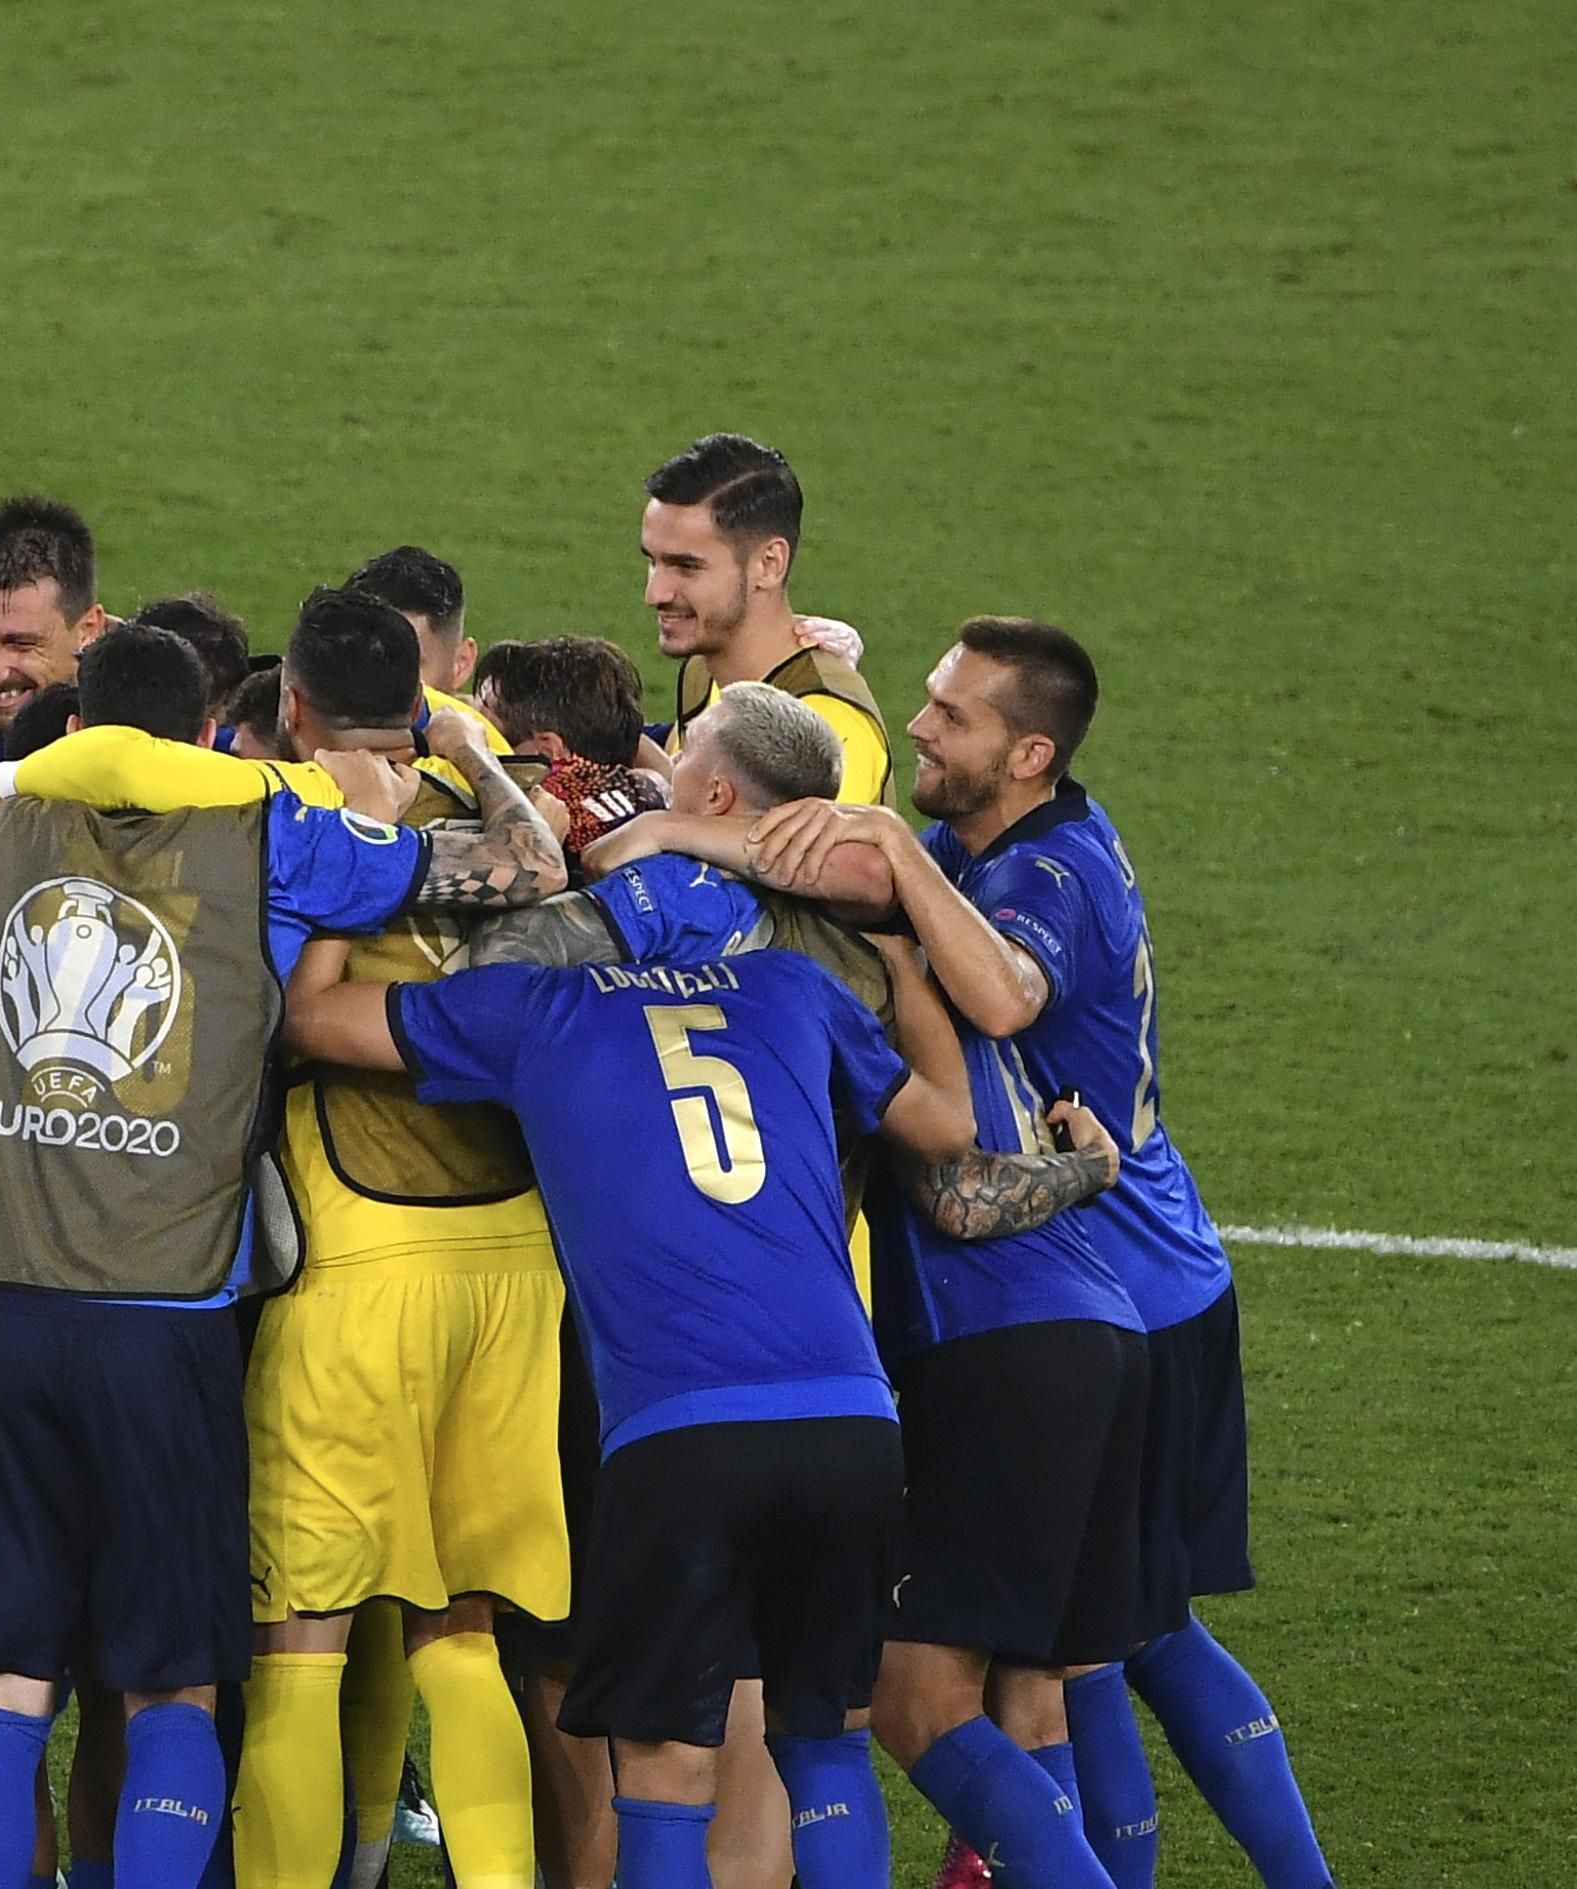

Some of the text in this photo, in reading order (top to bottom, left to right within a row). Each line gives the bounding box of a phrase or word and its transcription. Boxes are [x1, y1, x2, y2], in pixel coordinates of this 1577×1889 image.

[625, 867, 654, 914] ESPECT
[1017, 914, 1063, 956] RESPECT
[33, 1071, 98, 1104] UEFA
[643, 1003, 767, 1205] 5
[134, 1797, 209, 1827] ITALIA
